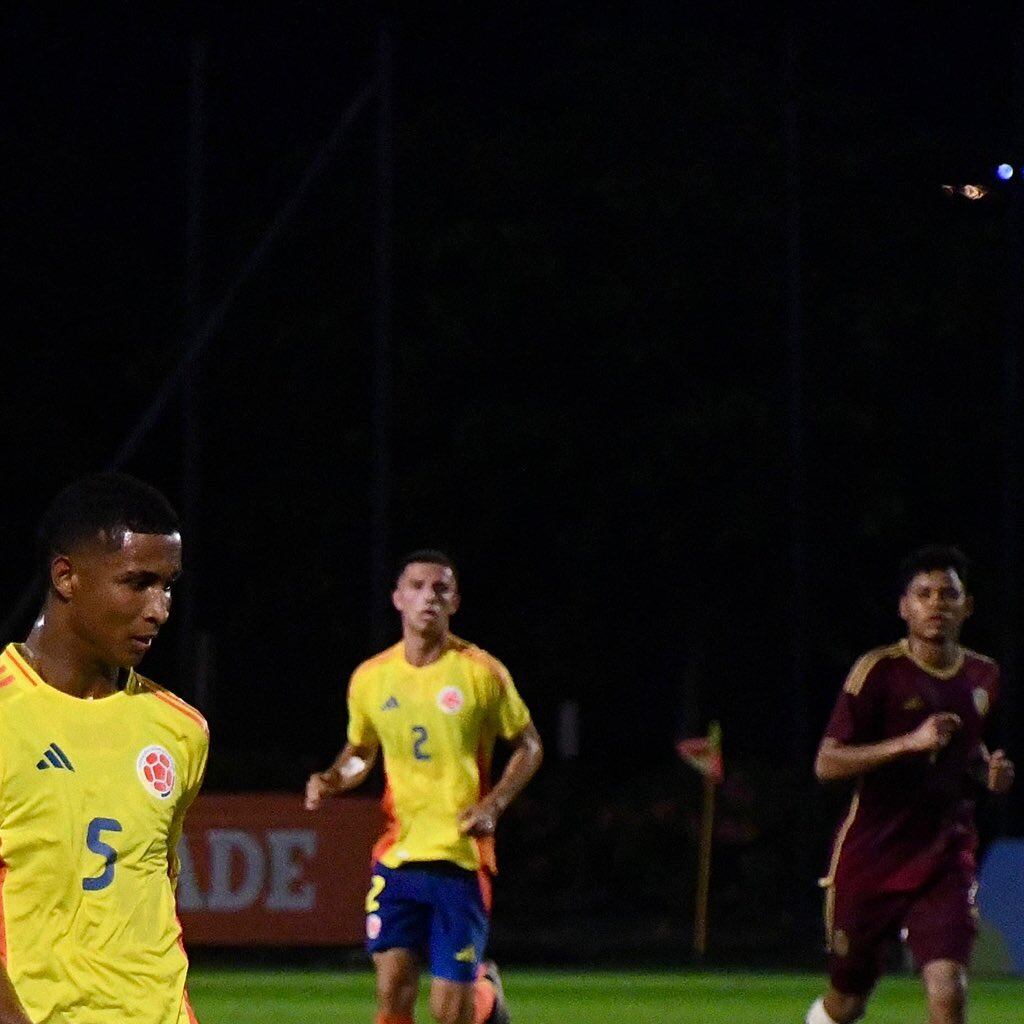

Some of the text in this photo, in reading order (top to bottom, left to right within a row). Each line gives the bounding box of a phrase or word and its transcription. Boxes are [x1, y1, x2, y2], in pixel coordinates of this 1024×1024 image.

[411, 726, 431, 761] 2
[82, 817, 123, 891] 5
[365, 875, 386, 913] 2
